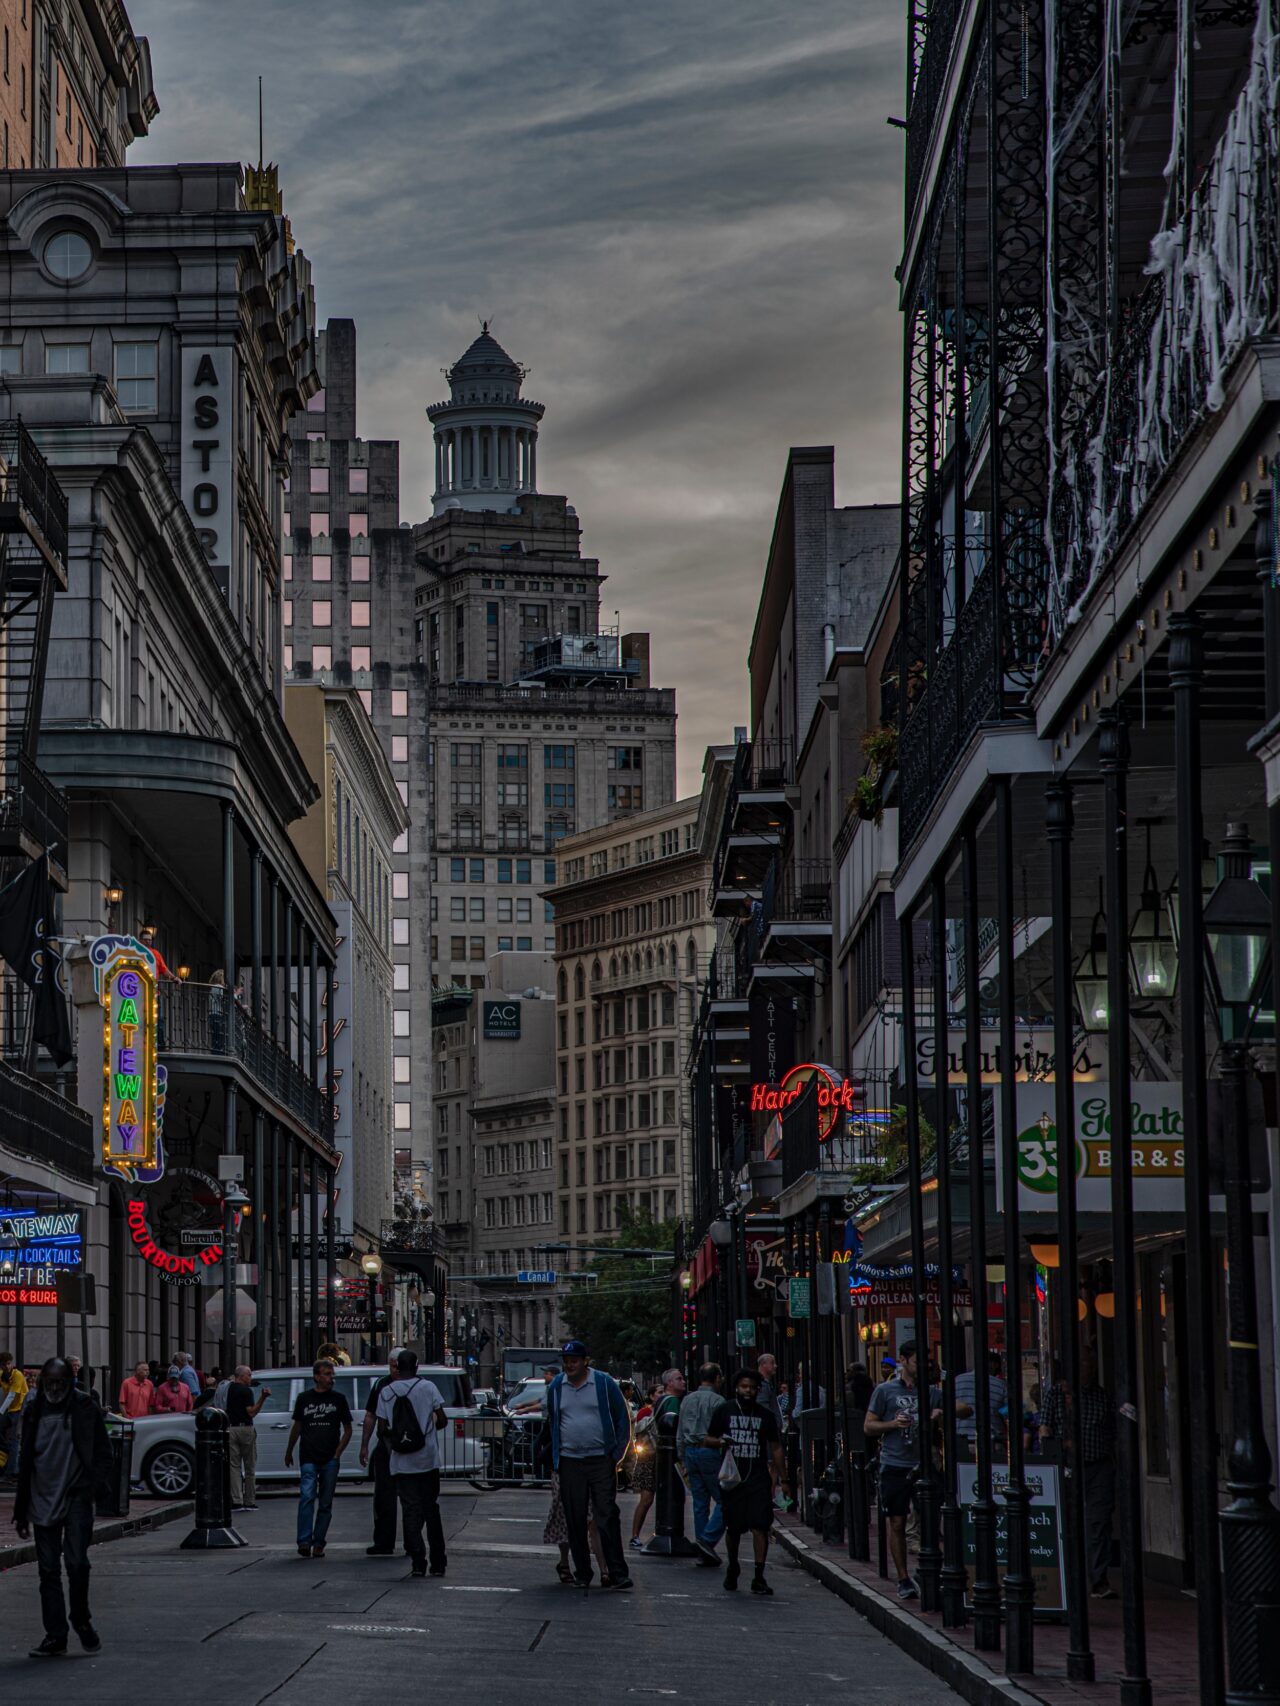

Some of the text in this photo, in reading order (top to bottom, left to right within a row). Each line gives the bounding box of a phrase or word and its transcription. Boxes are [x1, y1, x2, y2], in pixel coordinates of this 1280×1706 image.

[193, 354, 219, 560] ASTOR
[489, 1005, 517, 1020] AC
[115, 971, 142, 1151] GATEWAY
[750, 1079, 854, 1112] Hard ock
[1097, 1150, 1146, 1168] BR
[1151, 1150, 1169, 1168] &
[127, 1200, 195, 1275] BOURBON
[184, 1233, 221, 1244] Iberville
[24, 1247, 81, 1265] COCKTAILS
[318, 1245, 345, 1254] ASOR
[527, 1271, 549, 1282] Canal
[874, 1280, 940, 1292] AUTHEIC
[850, 1292, 971, 1306] EW ORLEAN CUINE
